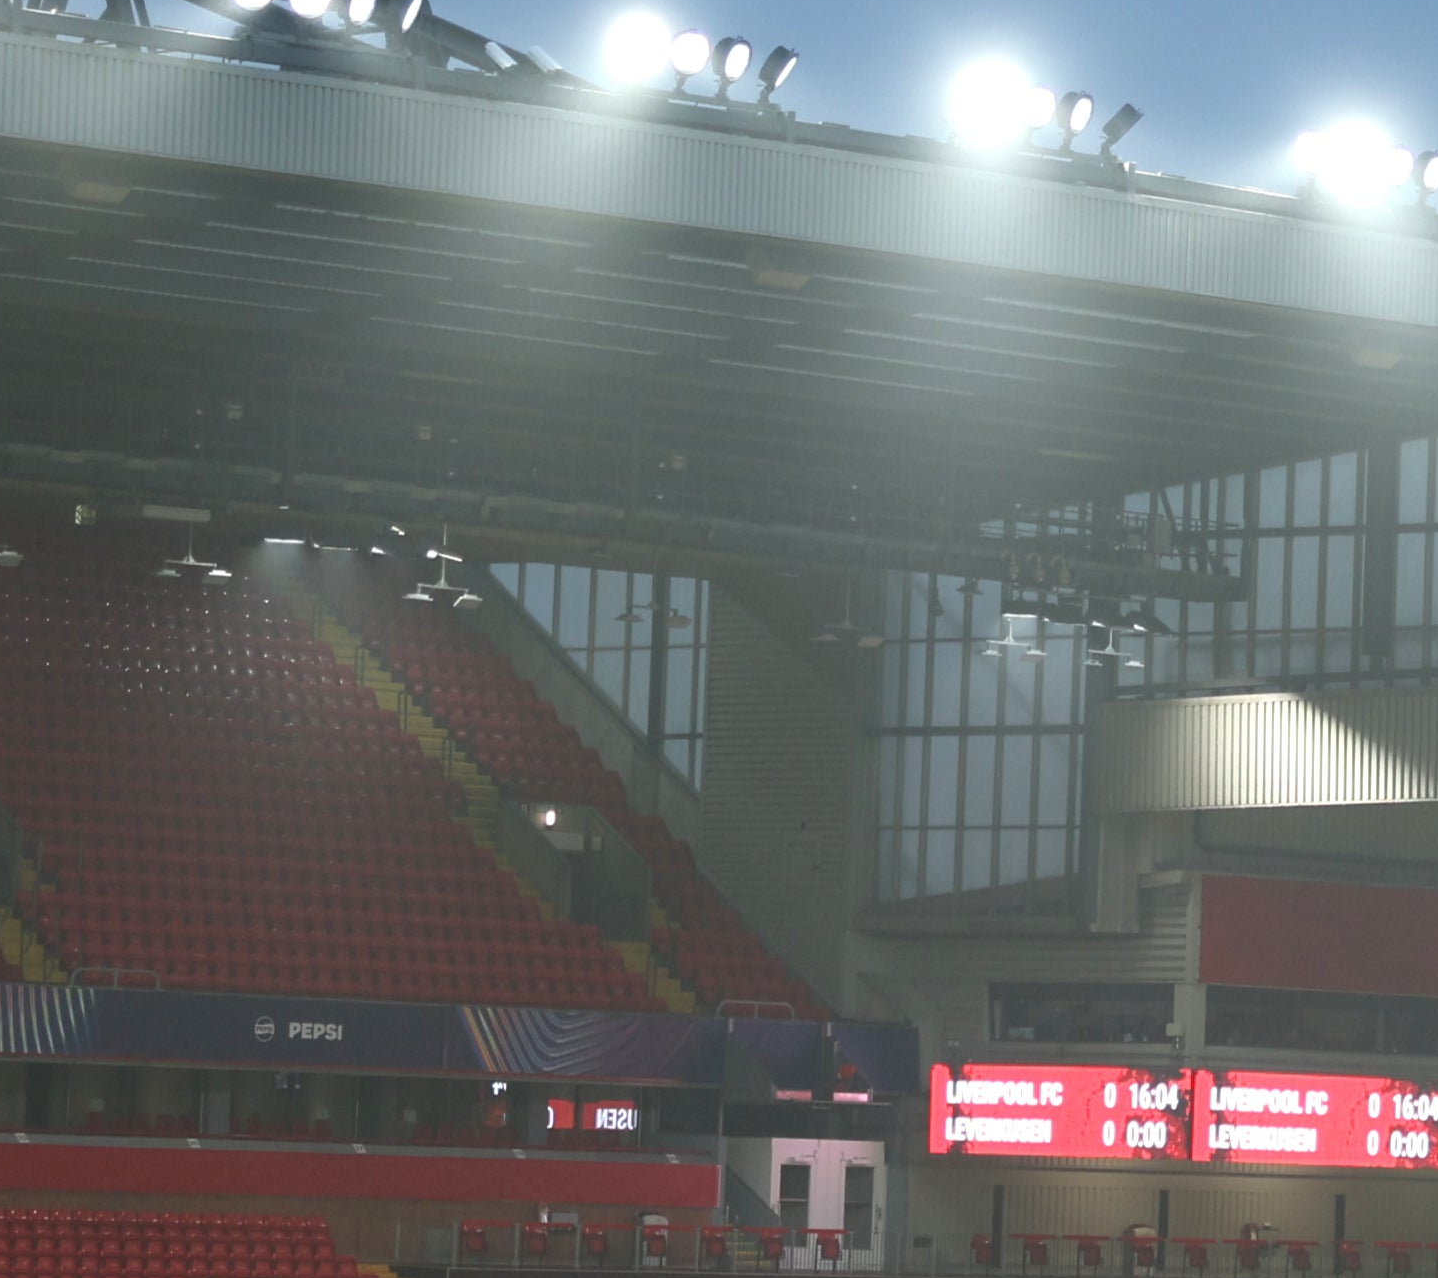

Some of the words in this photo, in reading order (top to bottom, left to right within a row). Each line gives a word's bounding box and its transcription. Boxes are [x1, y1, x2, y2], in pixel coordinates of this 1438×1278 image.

[288, 1021, 343, 1041] PEPSI
[946, 1080, 1037, 1105] LIVERPOOL
[1040, 1082, 1063, 1106] FC
[1104, 1082, 1117, 1108] 0
[1129, 1082, 1179, 1110] 16:04
[1210, 1086, 1302, 1113] LIVERPOOL
[1305, 1090, 1328, 1115] FC
[1368, 1092, 1381, 1118] 0
[945, 1117, 1052, 1143] LEVERKUSEN
[1103, 1120, 1116, 1146] 0
[1126, 1120, 1167, 1148] 0:00
[1209, 1123, 1316, 1152] LEVERKUSEN
[1367, 1129, 1379, 1155] 0
[1390, 1130, 1430, 1158] 0:00
